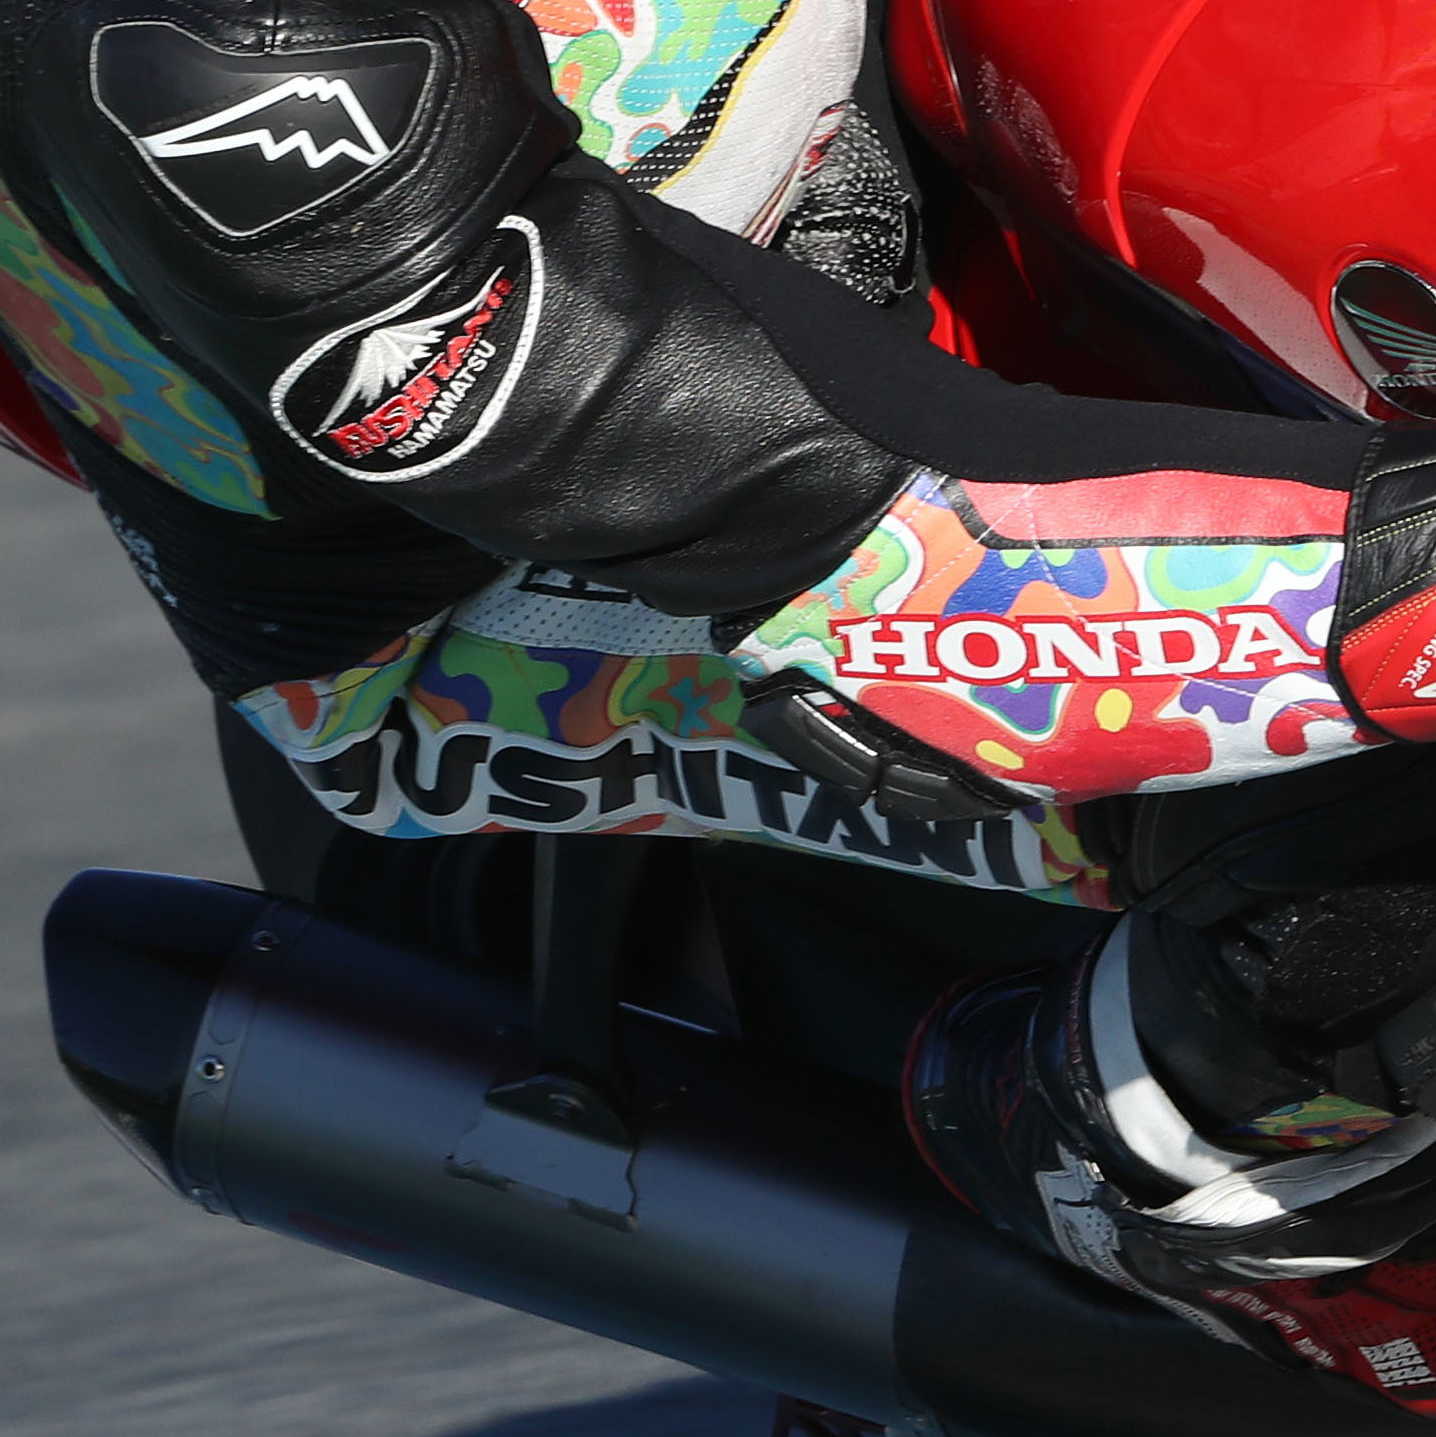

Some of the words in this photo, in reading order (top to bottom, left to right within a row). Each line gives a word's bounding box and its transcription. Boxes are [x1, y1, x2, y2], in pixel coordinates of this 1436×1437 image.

[387, 340, 498, 460] HAMAMATSU
[837, 614, 1322, 680] HONDA
[1398, 656, 1432, 690] SPEC.
